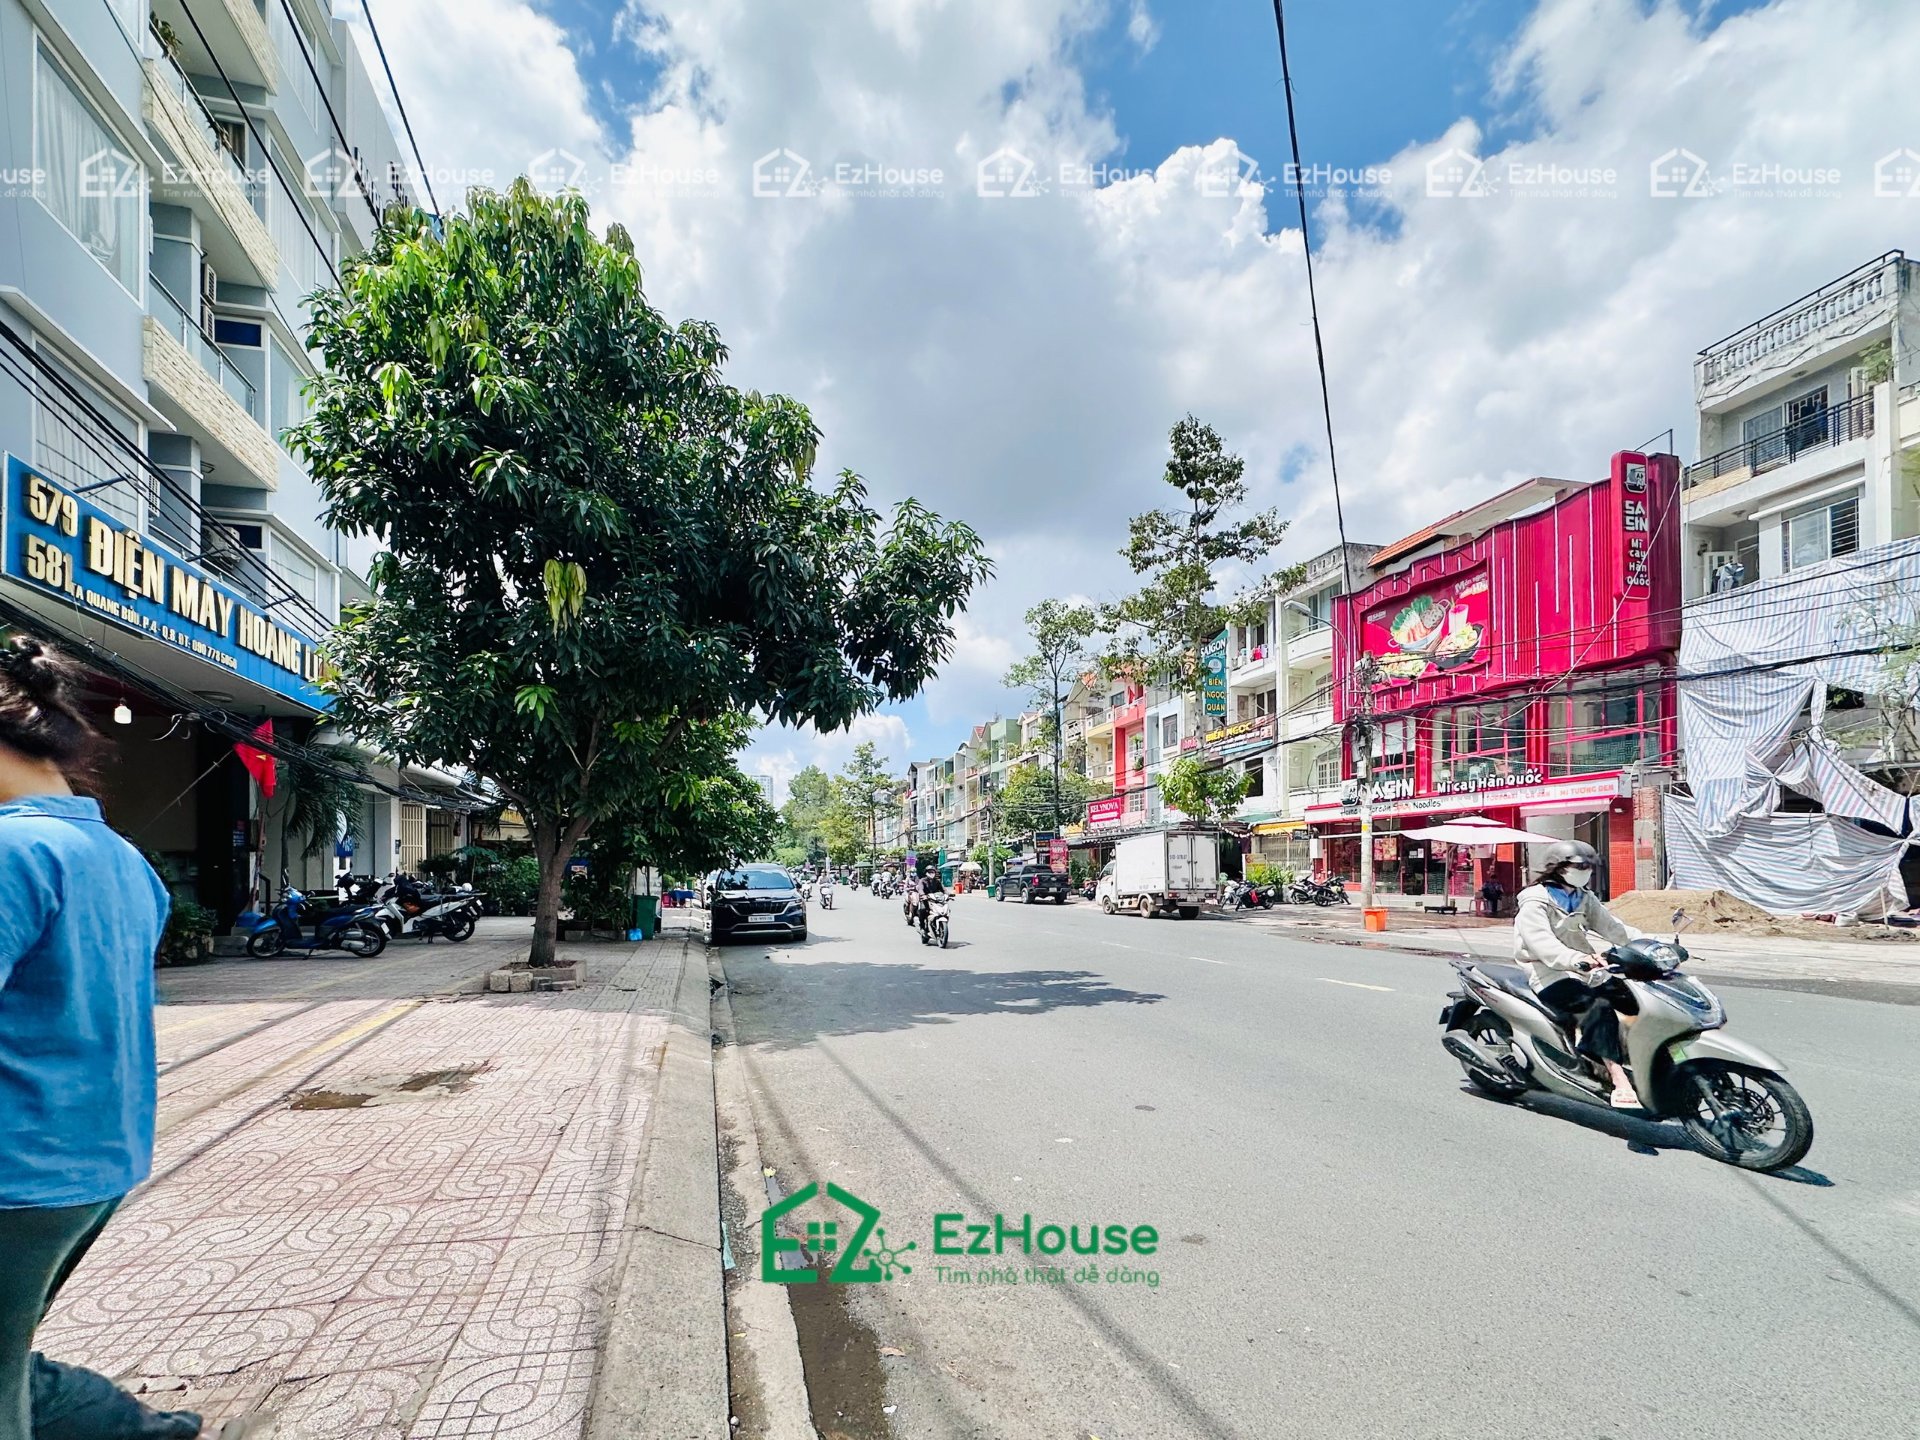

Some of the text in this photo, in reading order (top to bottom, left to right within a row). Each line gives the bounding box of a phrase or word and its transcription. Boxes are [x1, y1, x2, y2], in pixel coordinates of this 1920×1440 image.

[29, 474, 79, 537] 579
[1626, 501, 1645, 514] SA
[1626, 517, 1648, 531] SIN
[27, 534, 75, 594] 581
[1629, 549, 1647, 562] cay
[89, 516, 165, 605] ĐIỆN
[171, 565, 234, 638] MÁY
[86, 590, 120, 618] QUANG
[1453, 780, 1476, 793] cay
[1478, 774, 1505, 789] Hàn
[1506, 768, 1543, 786] Quốc
